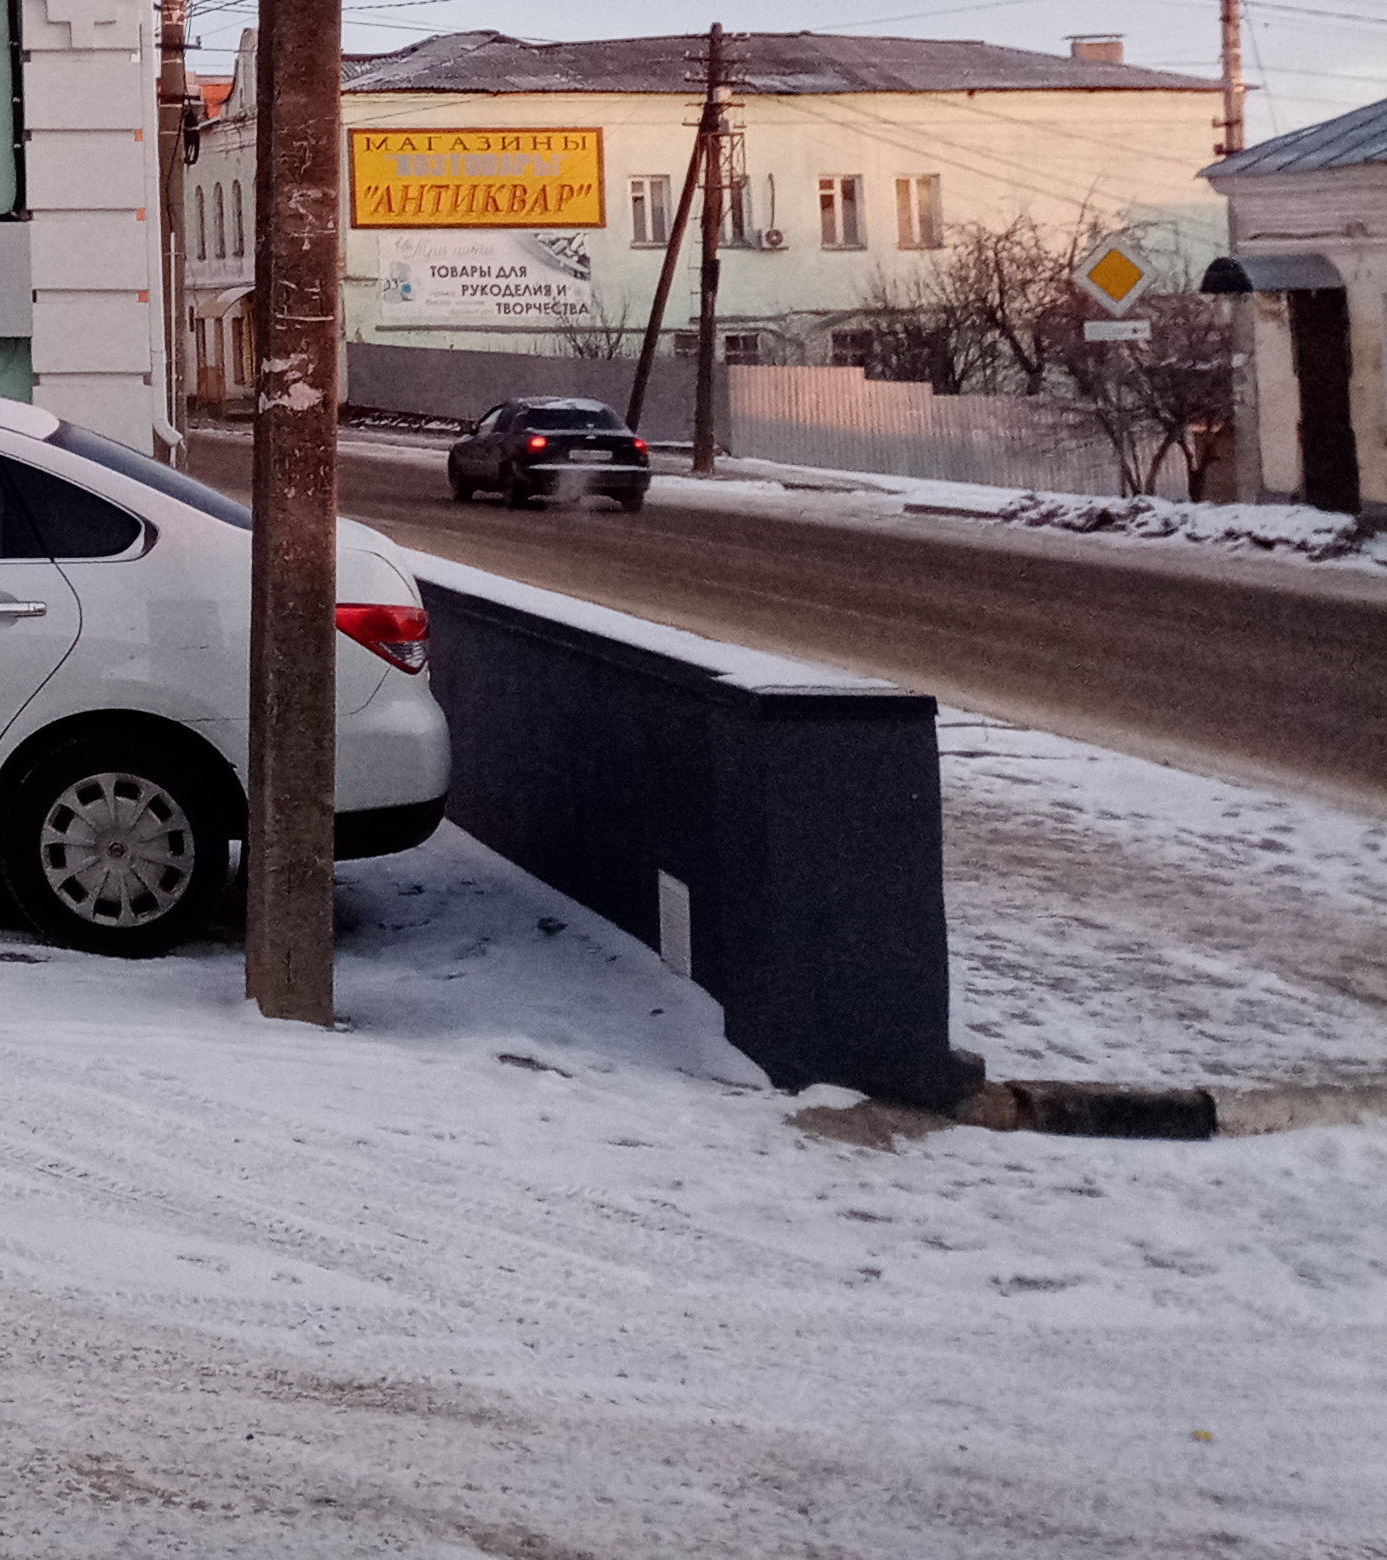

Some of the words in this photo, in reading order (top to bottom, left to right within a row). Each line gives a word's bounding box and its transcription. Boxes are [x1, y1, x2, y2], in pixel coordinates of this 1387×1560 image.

[362, 135, 590, 152] МАГАЗИНЫ
[430, 265, 492, 279] ТОВАРЫ
[495, 265, 528, 279] ДЛЯ
[460, 284, 553, 298] РУКОДЕЛИЯ
[556, 284, 567, 297] И
[495, 302, 591, 316] ТВОРЧЕСТВА
